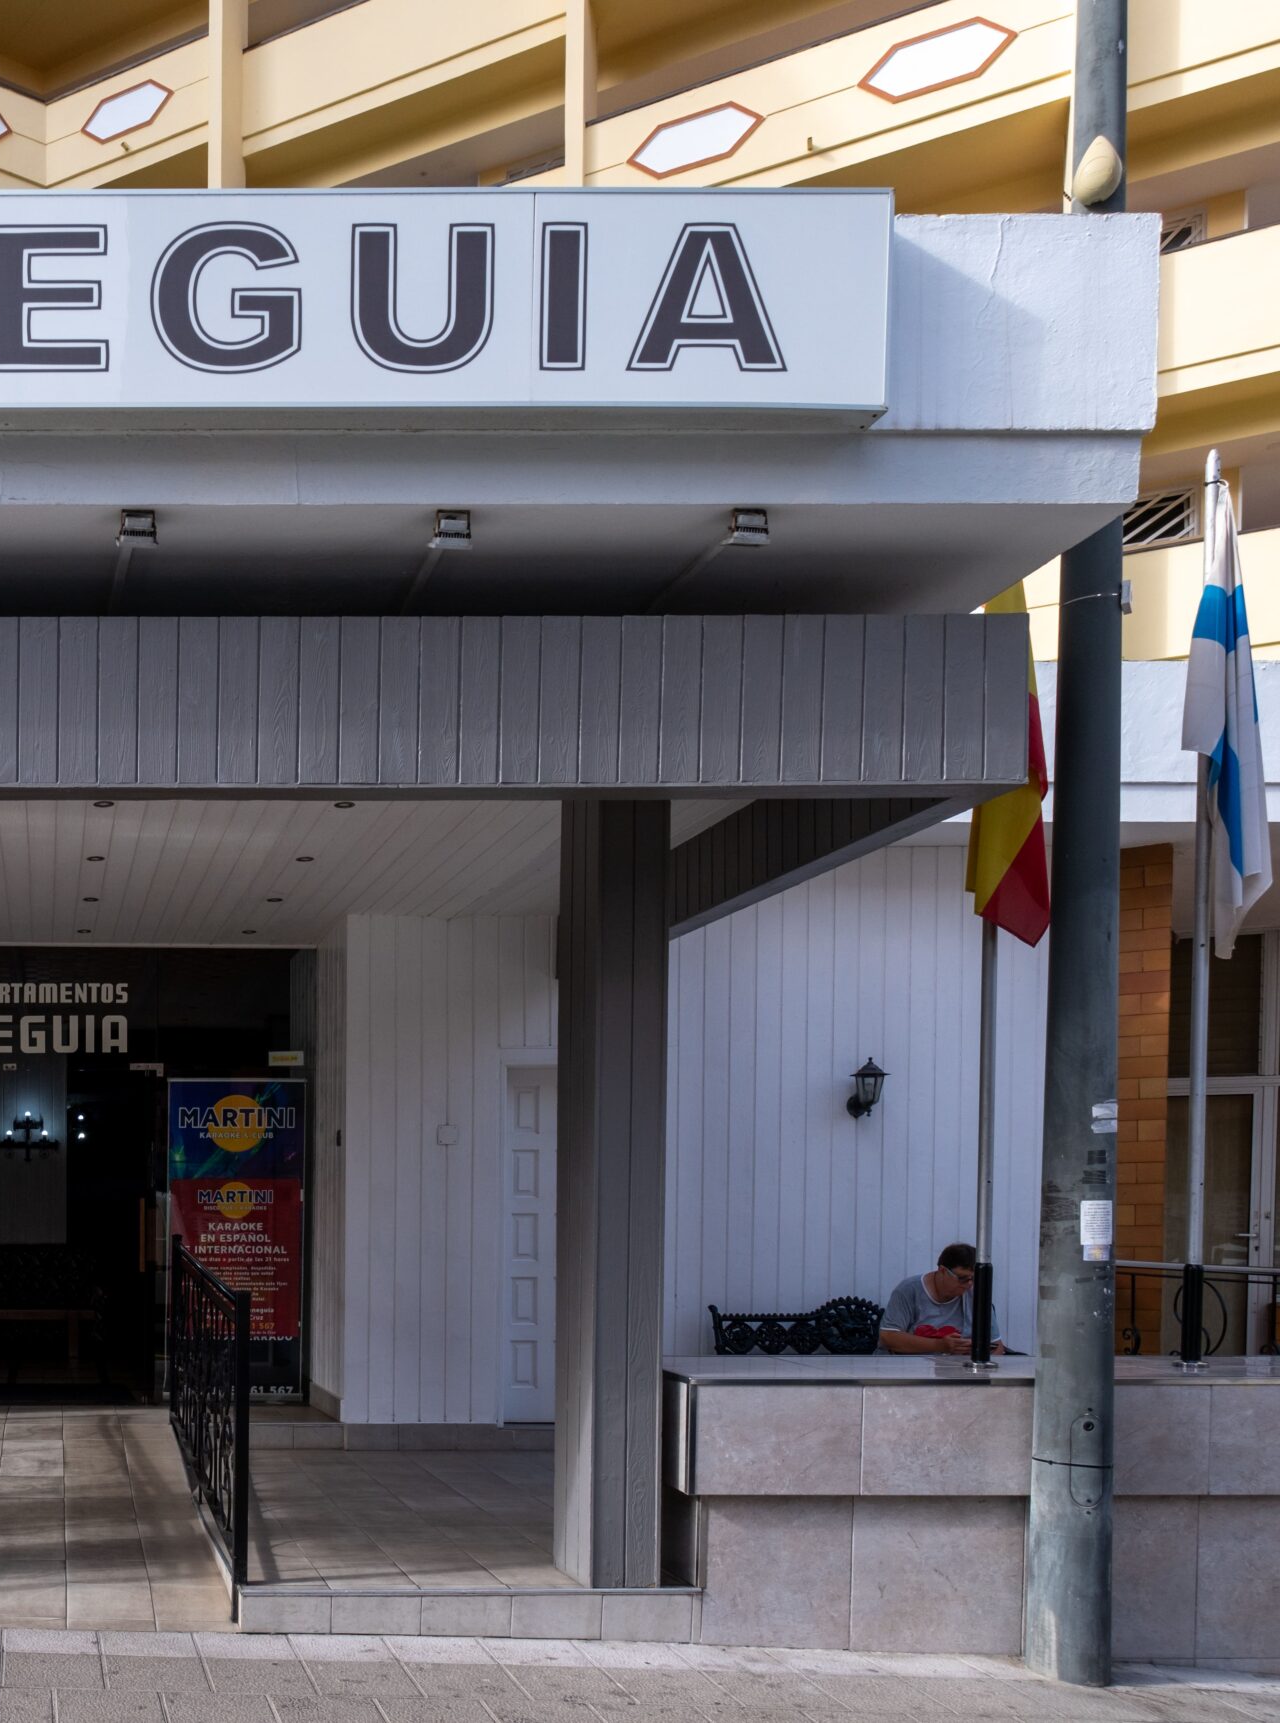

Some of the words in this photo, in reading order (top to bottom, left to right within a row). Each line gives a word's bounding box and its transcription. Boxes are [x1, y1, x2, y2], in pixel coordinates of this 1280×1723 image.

[178, 1106, 296, 1129] MARTINI
[199, 1131, 241, 1139] KARAOKE
[252, 1131, 274, 1139] CLUB
[197, 1189, 274, 1204] MARTINI
[208, 1222, 264, 1231] KARAOKE
[200, 1234, 216, 1243] EN
[220, 1231, 271, 1243] ESPAÑOL
[194, 1245, 288, 1255] INTERNACIONAL
